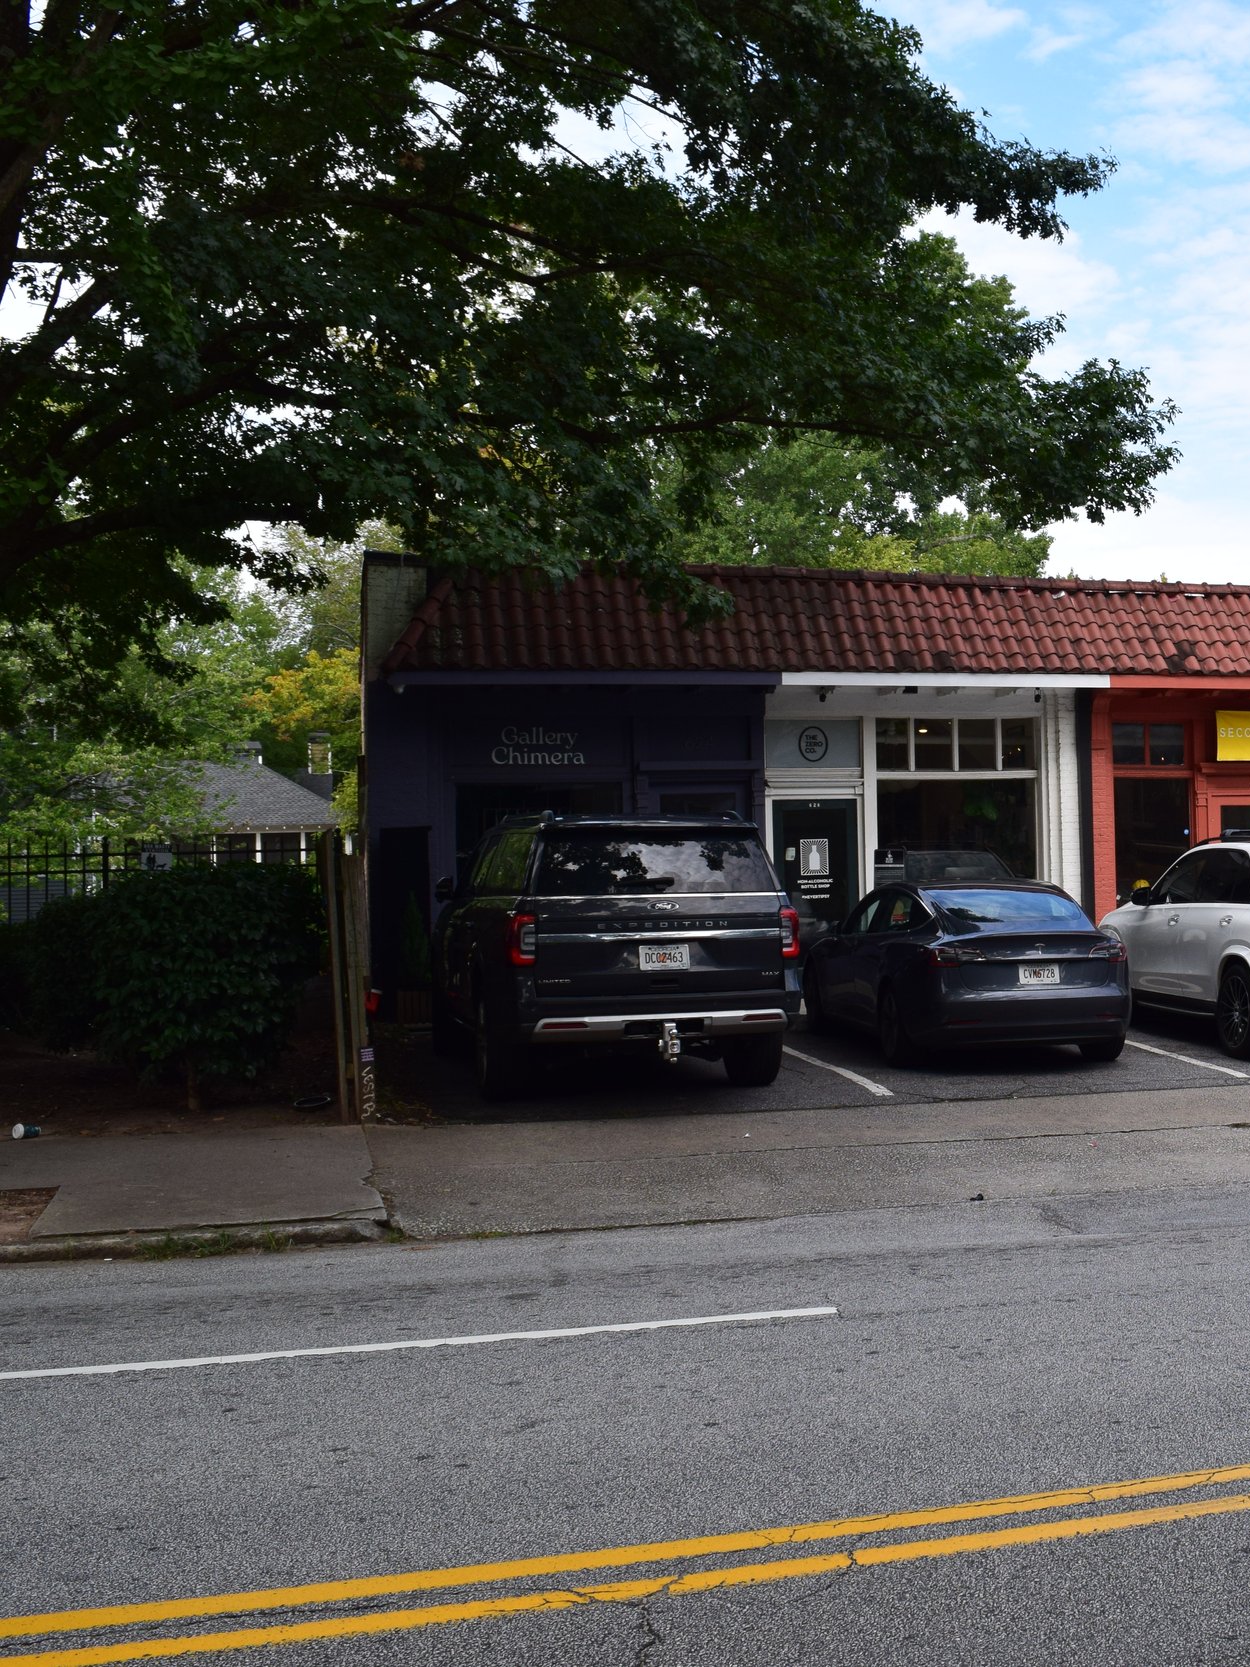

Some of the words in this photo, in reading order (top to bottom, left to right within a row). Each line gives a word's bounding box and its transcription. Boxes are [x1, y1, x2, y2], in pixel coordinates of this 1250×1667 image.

[501, 726, 578, 749] Gallery
[491, 746, 586, 765] Chimera
[597, 920, 729, 930] EXPEDITION
